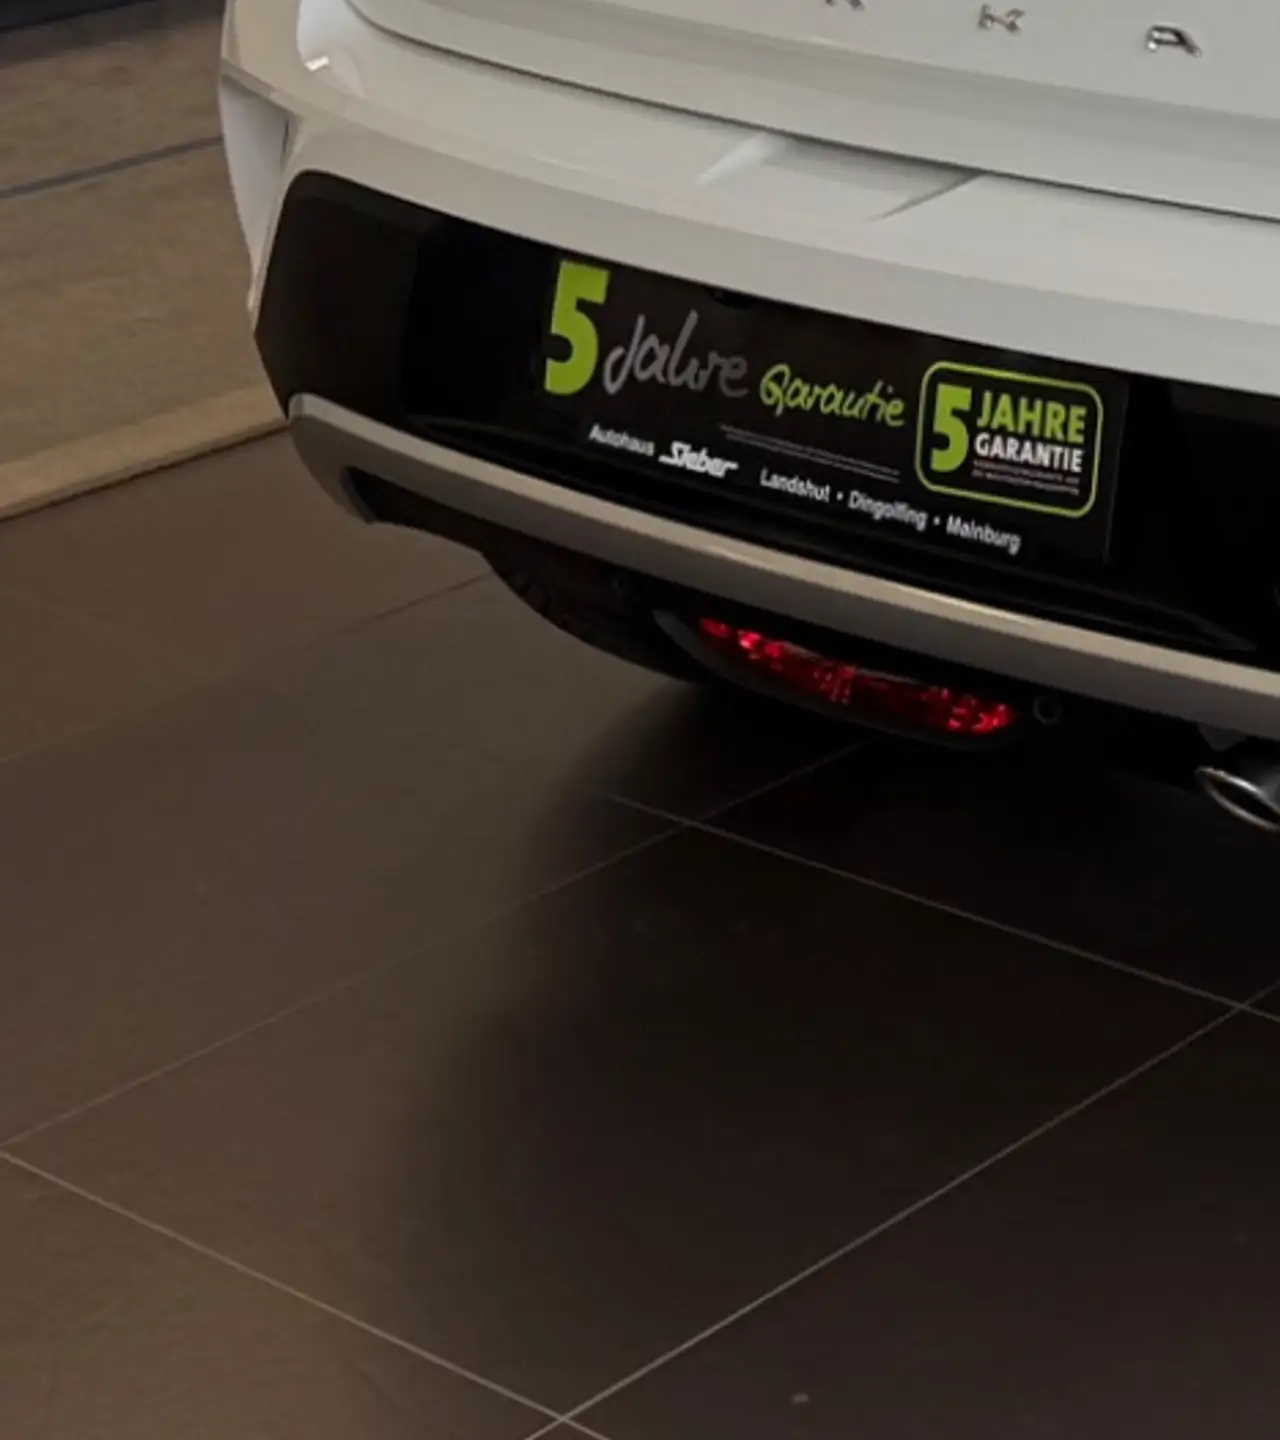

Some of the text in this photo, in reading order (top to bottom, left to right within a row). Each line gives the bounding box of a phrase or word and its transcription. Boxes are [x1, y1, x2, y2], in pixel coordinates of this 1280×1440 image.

[545, 260, 609, 395] 5
[603, 309, 749, 398] Jahre
[588, 423, 656, 457] Autohaus
[930, 382, 972, 473] 5
[973, 431, 1084, 474] GARANTIE
[976, 389, 1088, 445] JAHRE
[760, 467, 1022, 556] Landshut Dingolfing Mainburg
